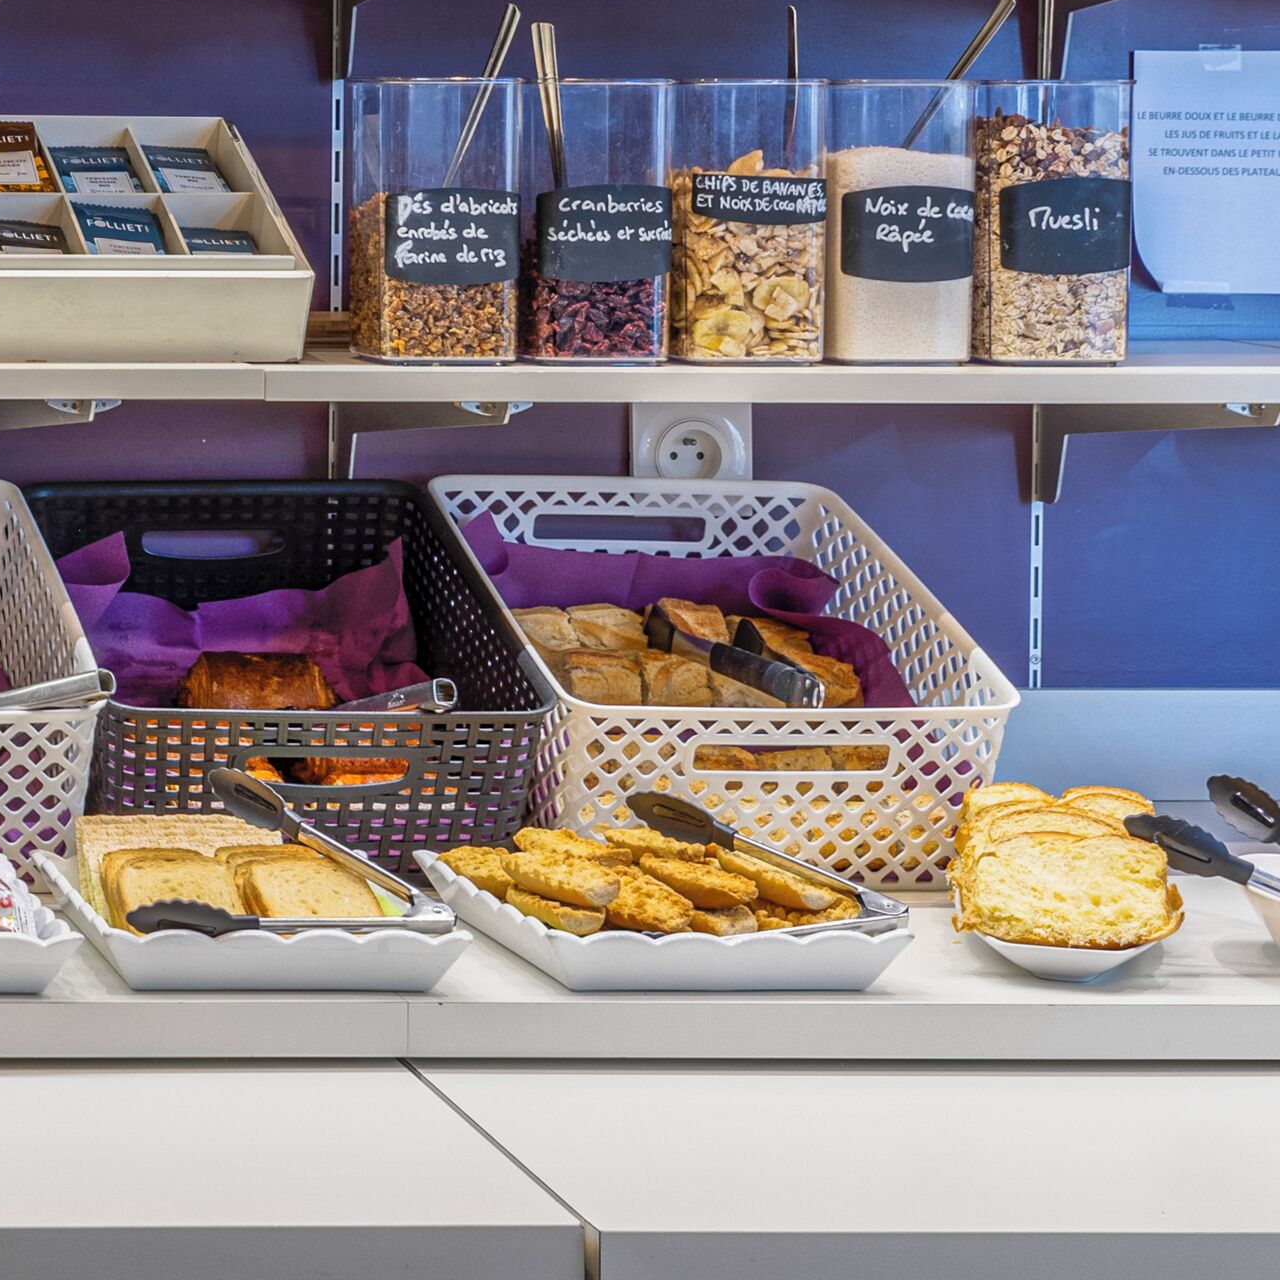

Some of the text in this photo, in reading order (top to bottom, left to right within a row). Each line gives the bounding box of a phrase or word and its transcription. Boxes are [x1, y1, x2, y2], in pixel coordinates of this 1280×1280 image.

[1137, 111, 1146, 120] LE
[1148, 111, 1182, 121] BEURRE
[1185, 111, 1211, 121] DOUX
[1214, 112, 1224, 121] ET
[1227, 112, 1237, 121] LE
[1239, 112, 1275, 121] BEURRE
[1164, 130, 1179, 139] LES
[1181, 130, 1197, 139] JUS
[1199, 130, 1211, 139] DE
[1213, 130, 1245, 139] FRUITS
[1247, 130, 1258, 140] ET
[1260, 131, 1270, 140] LE
[1148, 147, 1158, 157] SE
[1160, 148, 1209, 157] TROUVENT
[1210, 148, 1237, 158] DANS
[1238, 149, 1249, 158] LE
[1250, 149, 1276, 158] PETIT
[1163, 166, 1220, 176] EN-DESSOUS
[1222, 167, 1240, 176] DES
[695, 175, 737, 193] CHIPS
[741, 179, 760, 194] DE
[440, 193, 518, 216] d'abricots
[696, 193, 714, 208] ET
[753, 197, 773, 212] DE
[864, 195, 909, 216] Noix
[916, 195, 943, 218] de
[86, 218, 144, 233] FOLLIET
[1028, 205, 1101, 231] Muesli
[396, 219, 489, 241] enrobés de
[616, 225, 635, 241] et
[455, 243, 479, 263] de
[480, 248, 507, 268] riz
